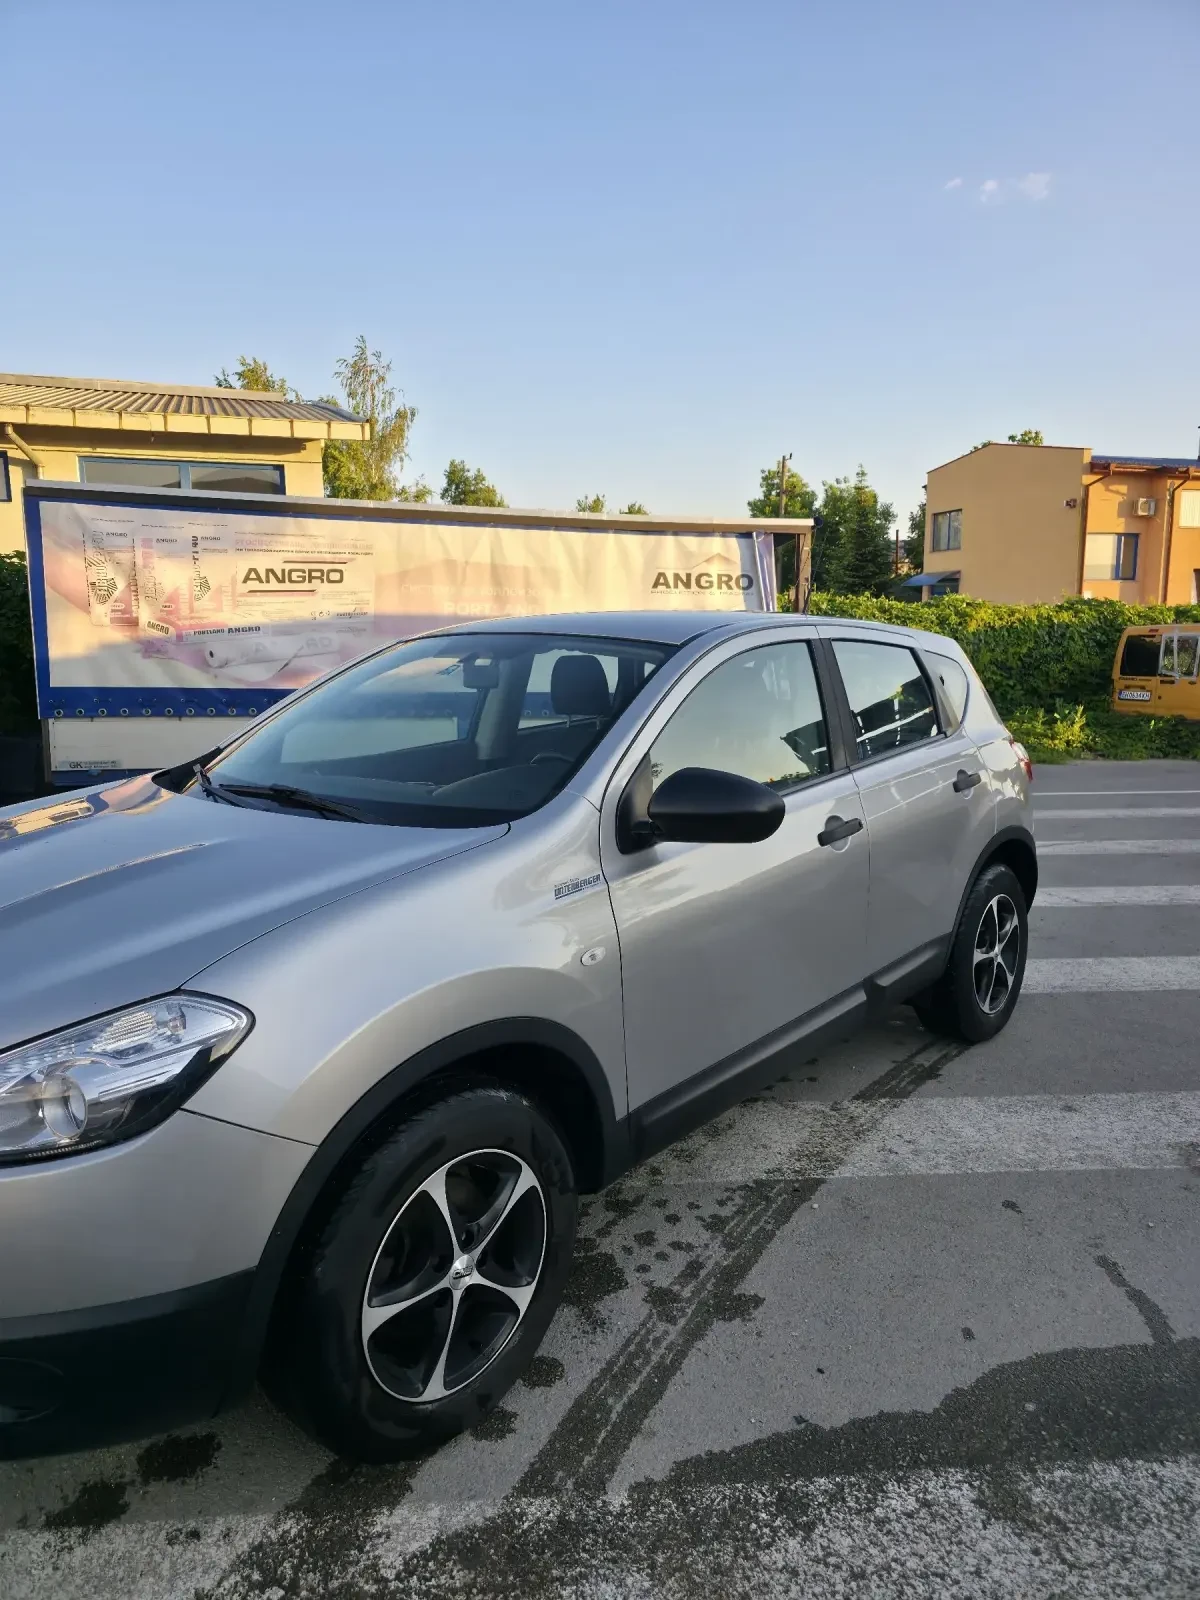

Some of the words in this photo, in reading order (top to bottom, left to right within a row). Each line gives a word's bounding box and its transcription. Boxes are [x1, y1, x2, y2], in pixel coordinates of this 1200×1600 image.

[242, 567, 344, 584] ANGRO
[651, 571, 754, 591] ANGRO
[147, 620, 170, 635] ANGRO
[193, 628, 225, 636] PORTLAND
[227, 625, 261, 635] ANGRO
